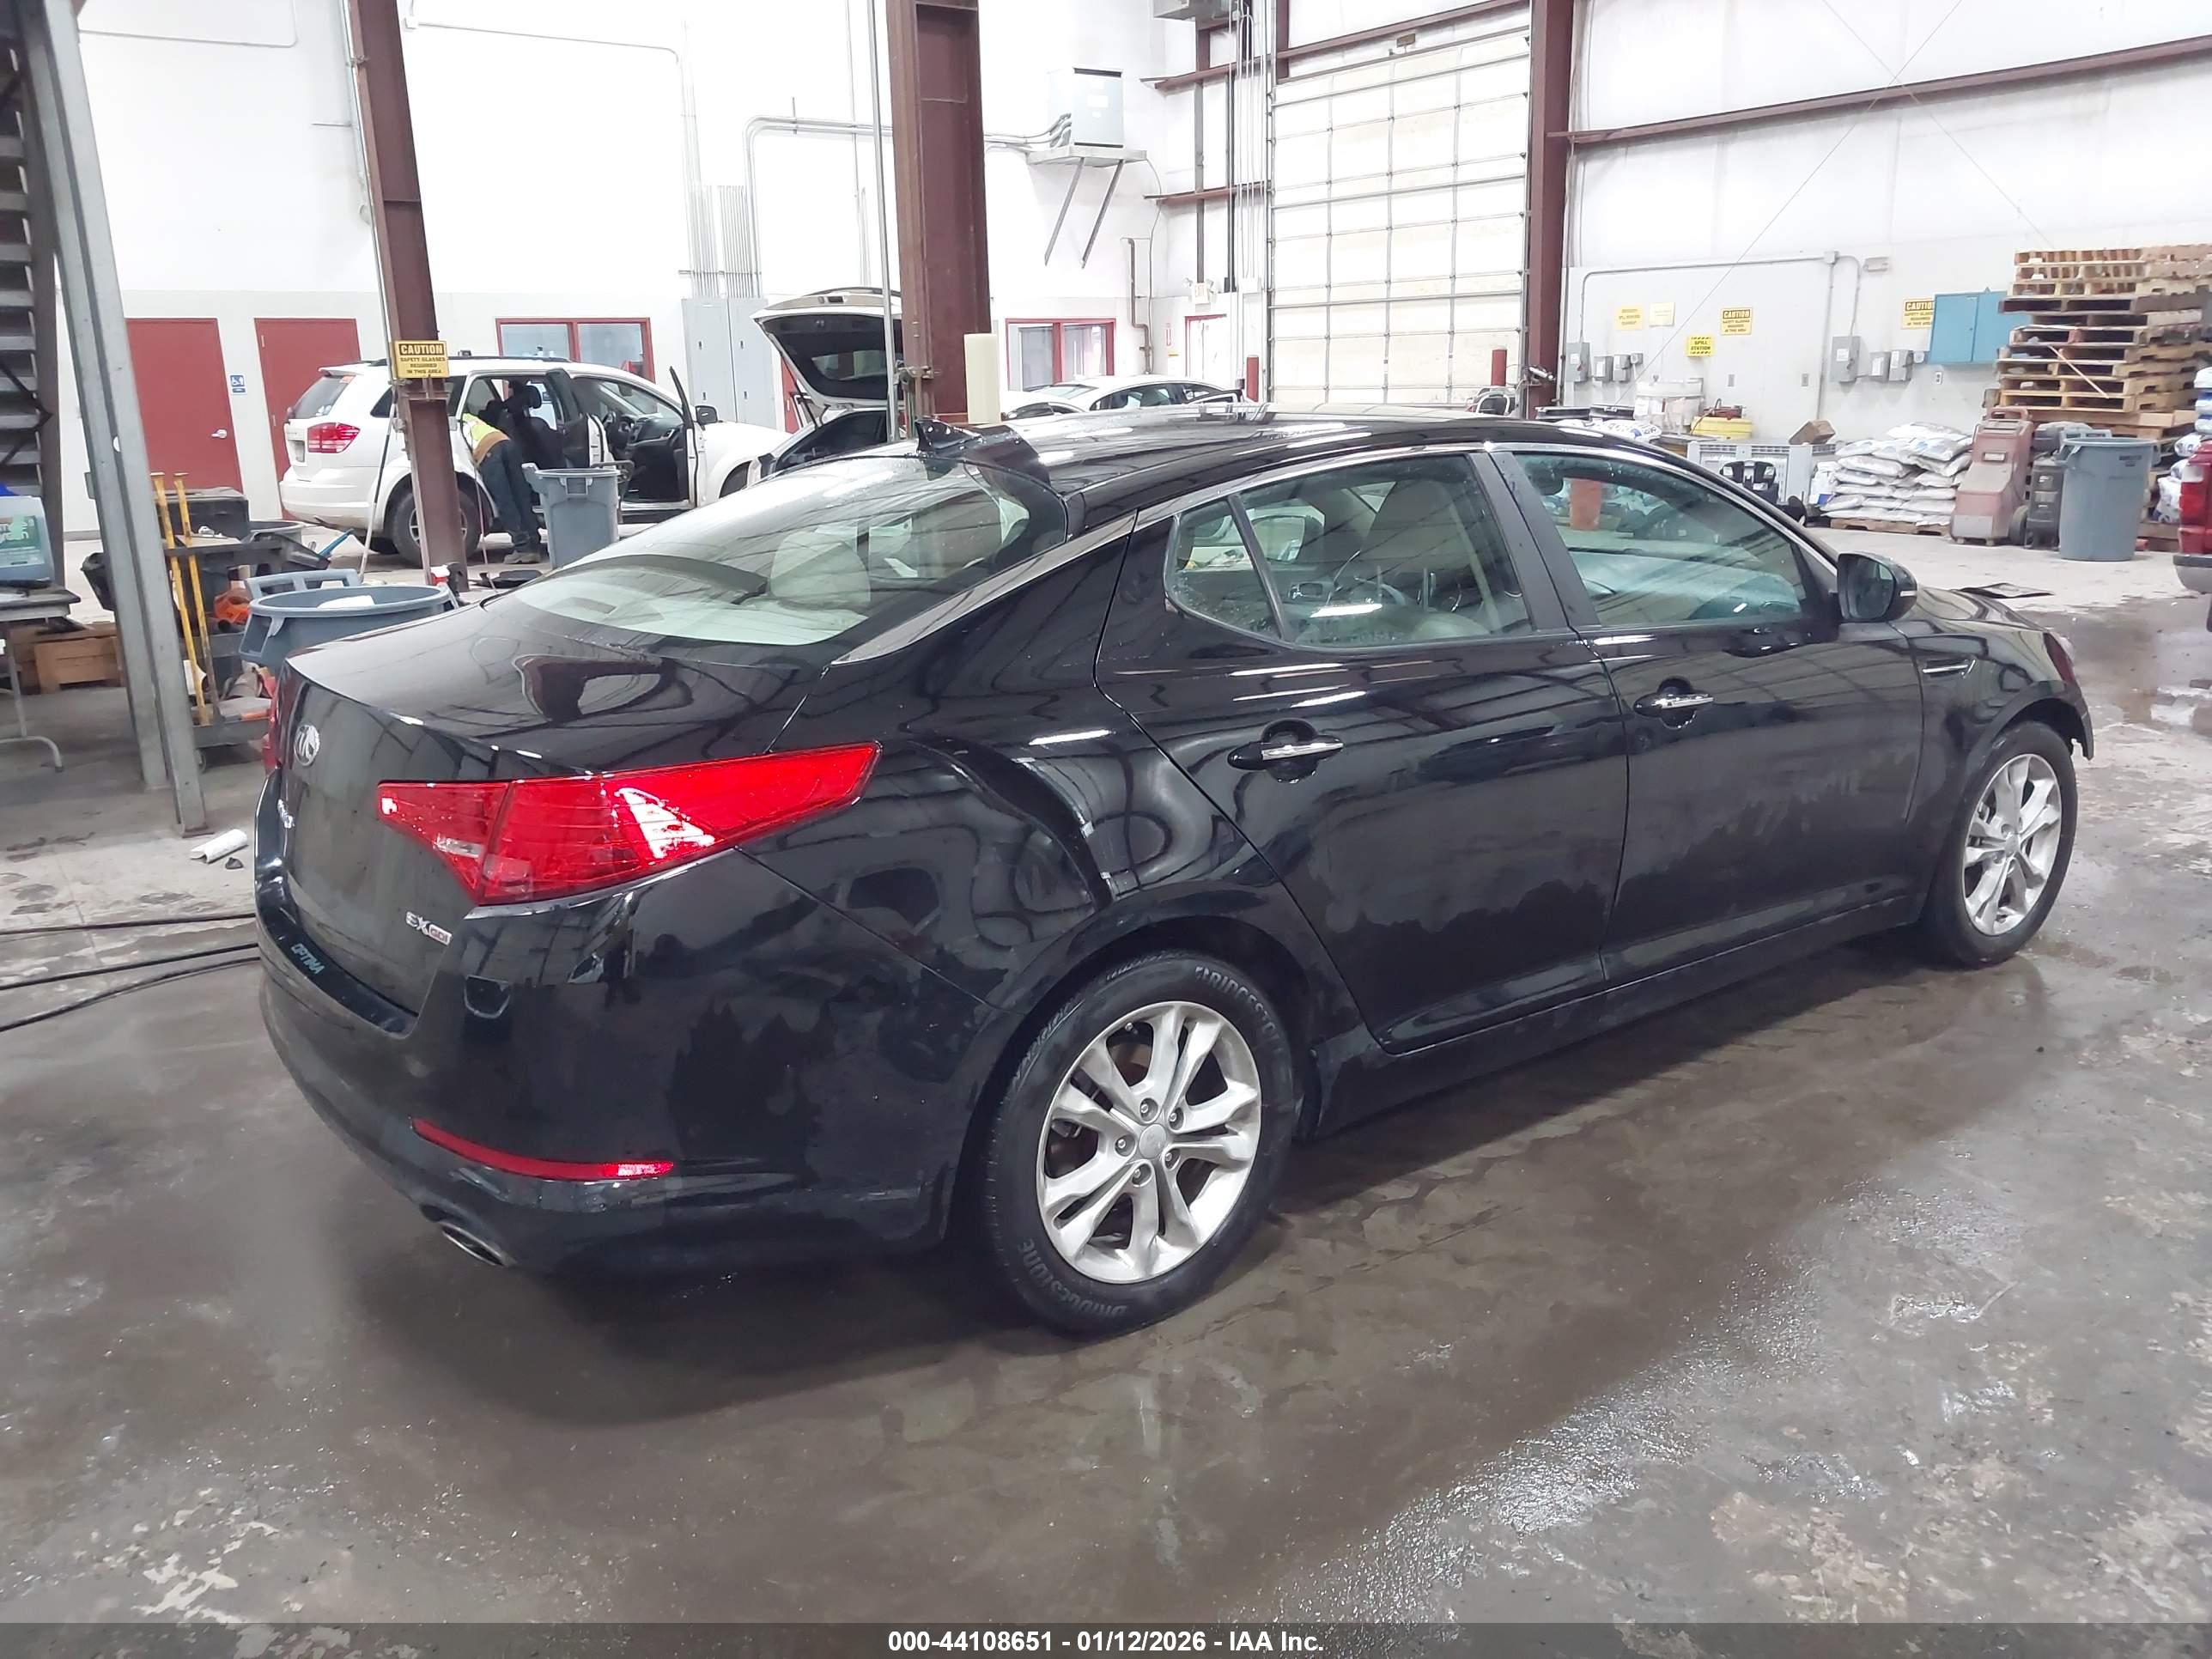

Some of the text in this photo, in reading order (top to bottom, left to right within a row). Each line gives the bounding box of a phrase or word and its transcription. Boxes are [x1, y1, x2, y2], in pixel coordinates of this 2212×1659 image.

[1723, 310, 1750, 319] CAUTION
[400, 344, 443, 355] CAUTION
[405, 911, 429, 936] EX
[291, 943, 325, 975] OPTIMA
